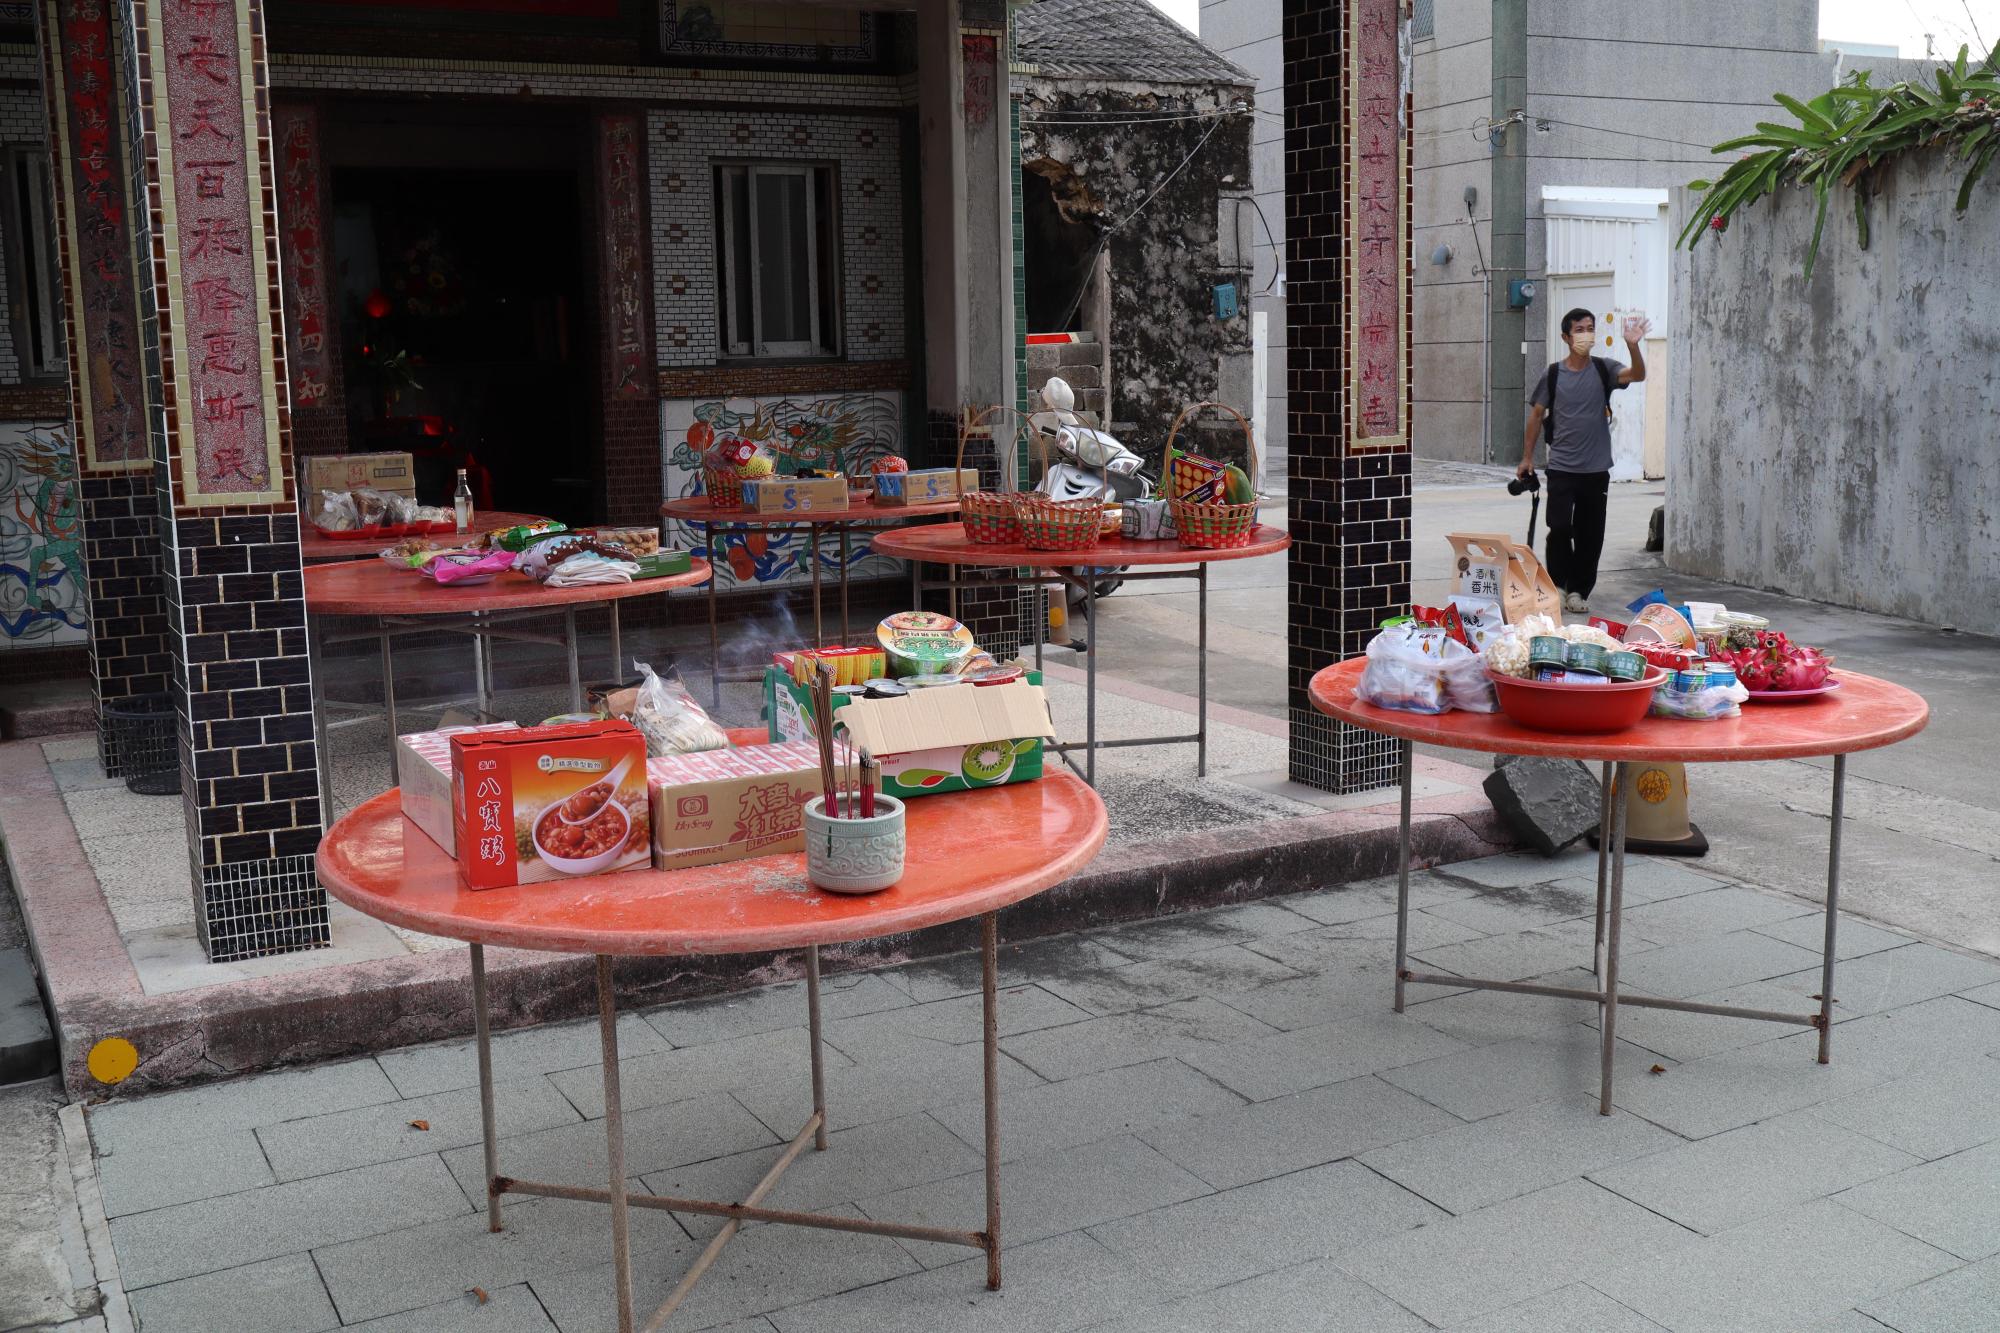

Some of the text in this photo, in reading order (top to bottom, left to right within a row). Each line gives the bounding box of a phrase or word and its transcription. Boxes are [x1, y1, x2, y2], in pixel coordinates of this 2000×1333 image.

[476, 777, 507, 866] 八寶粥
[748, 803, 802, 840] 紅茶
